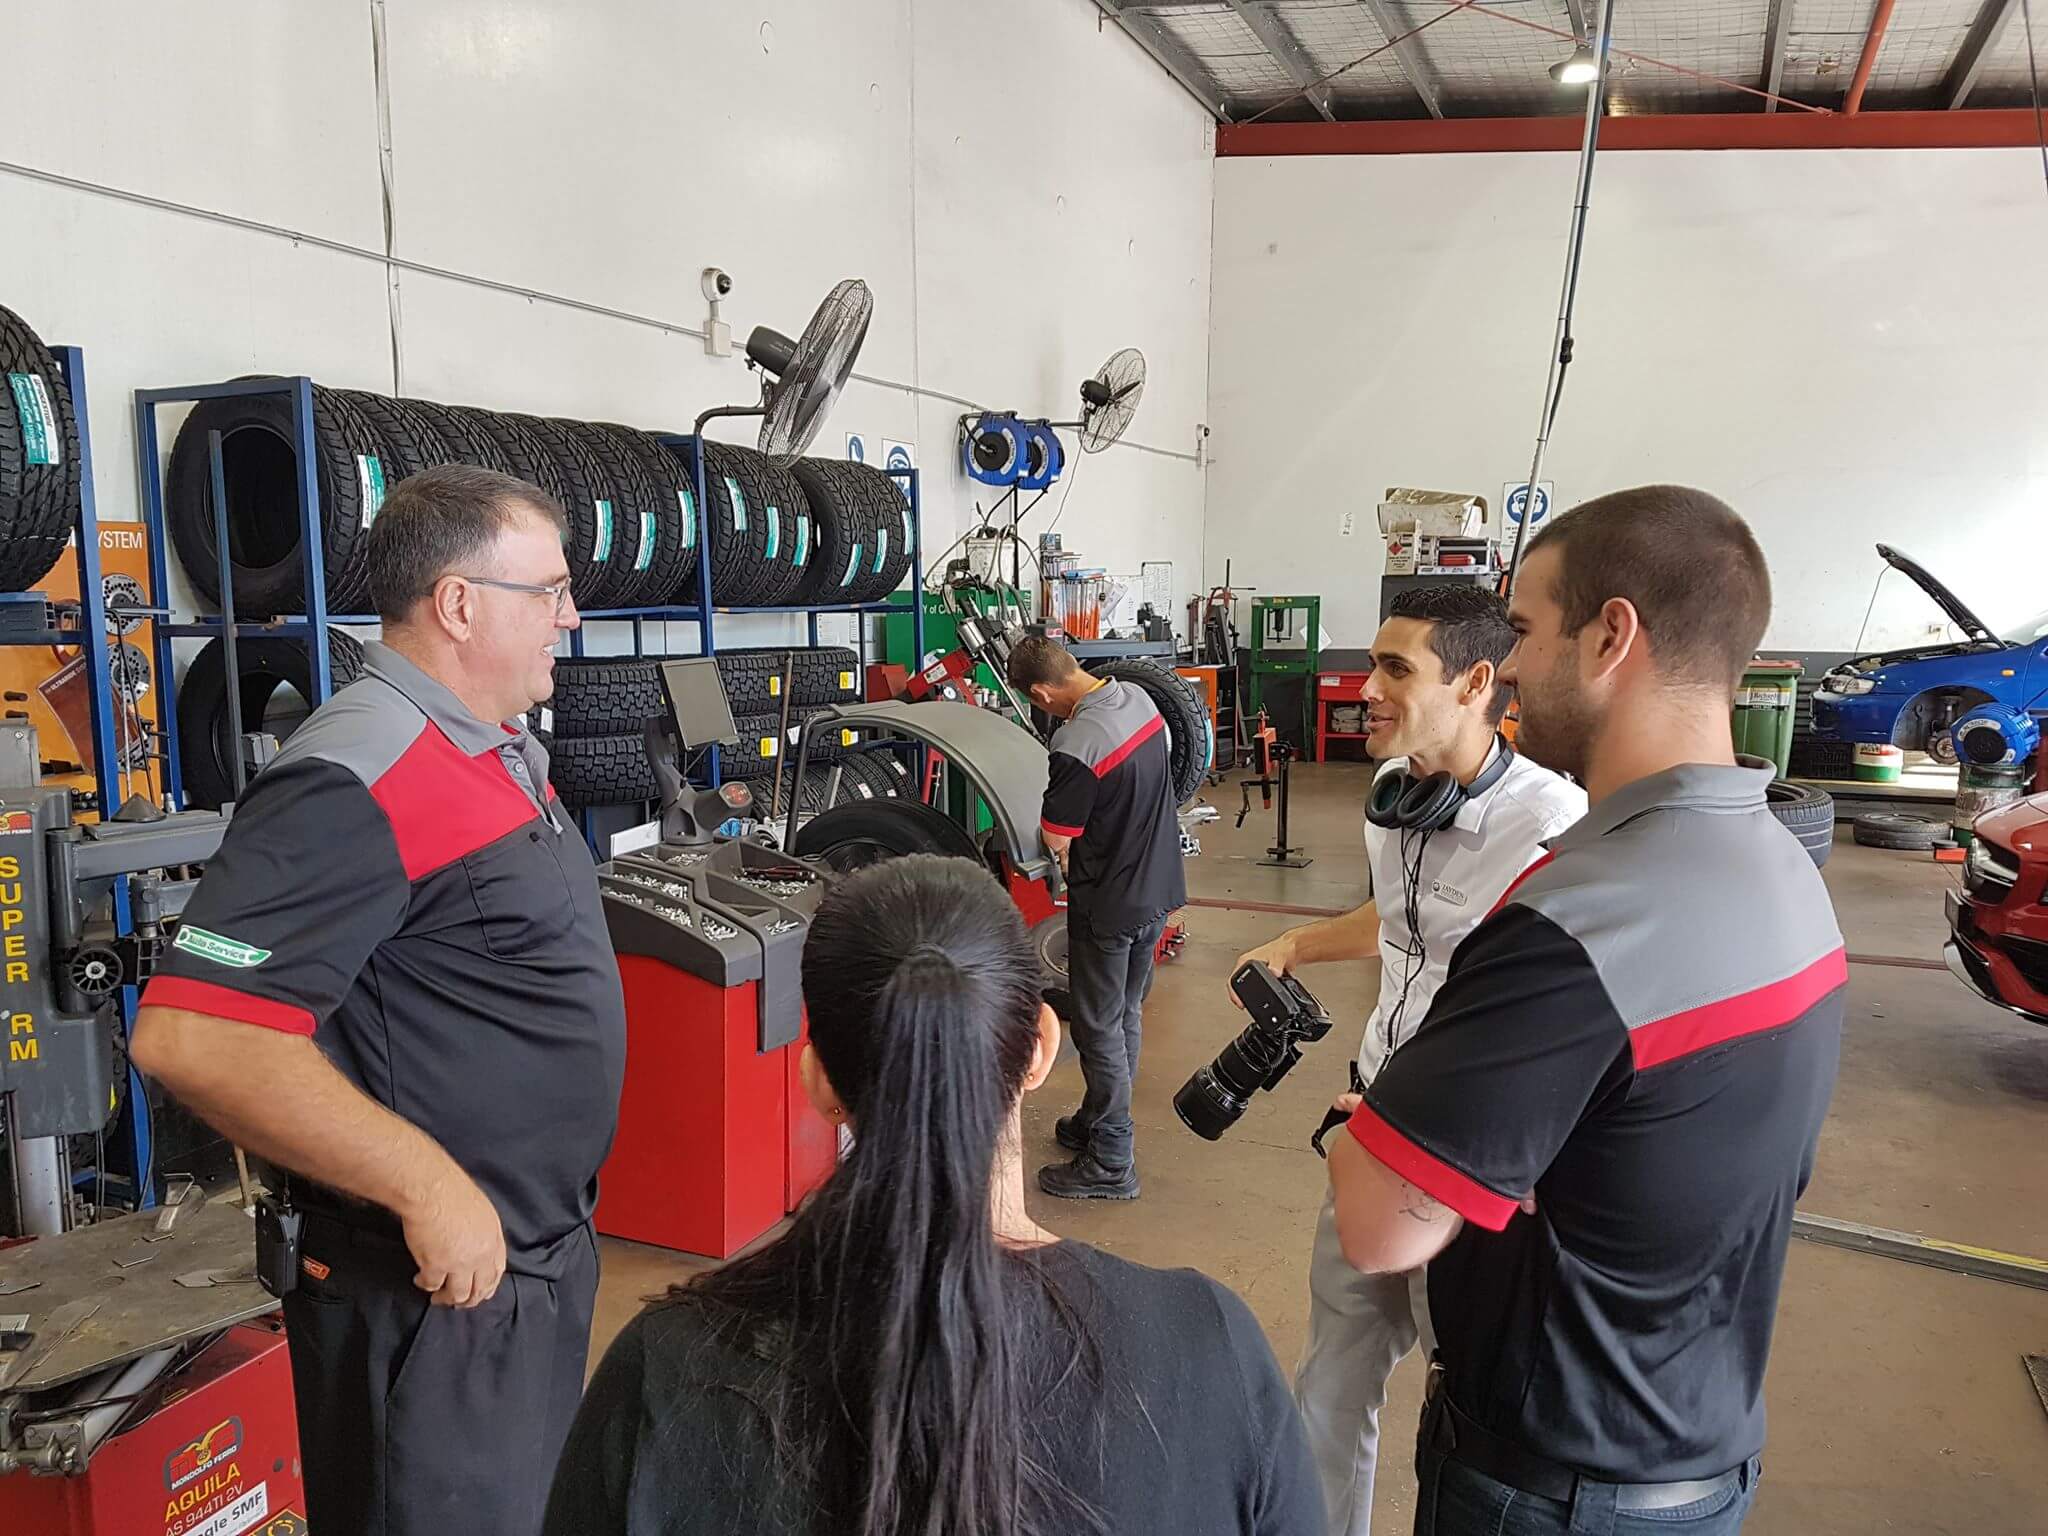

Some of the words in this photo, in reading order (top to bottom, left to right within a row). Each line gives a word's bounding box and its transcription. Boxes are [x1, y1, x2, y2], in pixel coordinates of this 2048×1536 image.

[97, 530, 143, 549] YSTEM
[171, 1459, 213, 1490] MONDOLFO
[213, 1445, 237, 1464] FERRO
[165, 1462, 241, 1522] AQUILA
[225, 1480, 244, 1502] 2V
[231, 1490, 263, 1520] SMF
